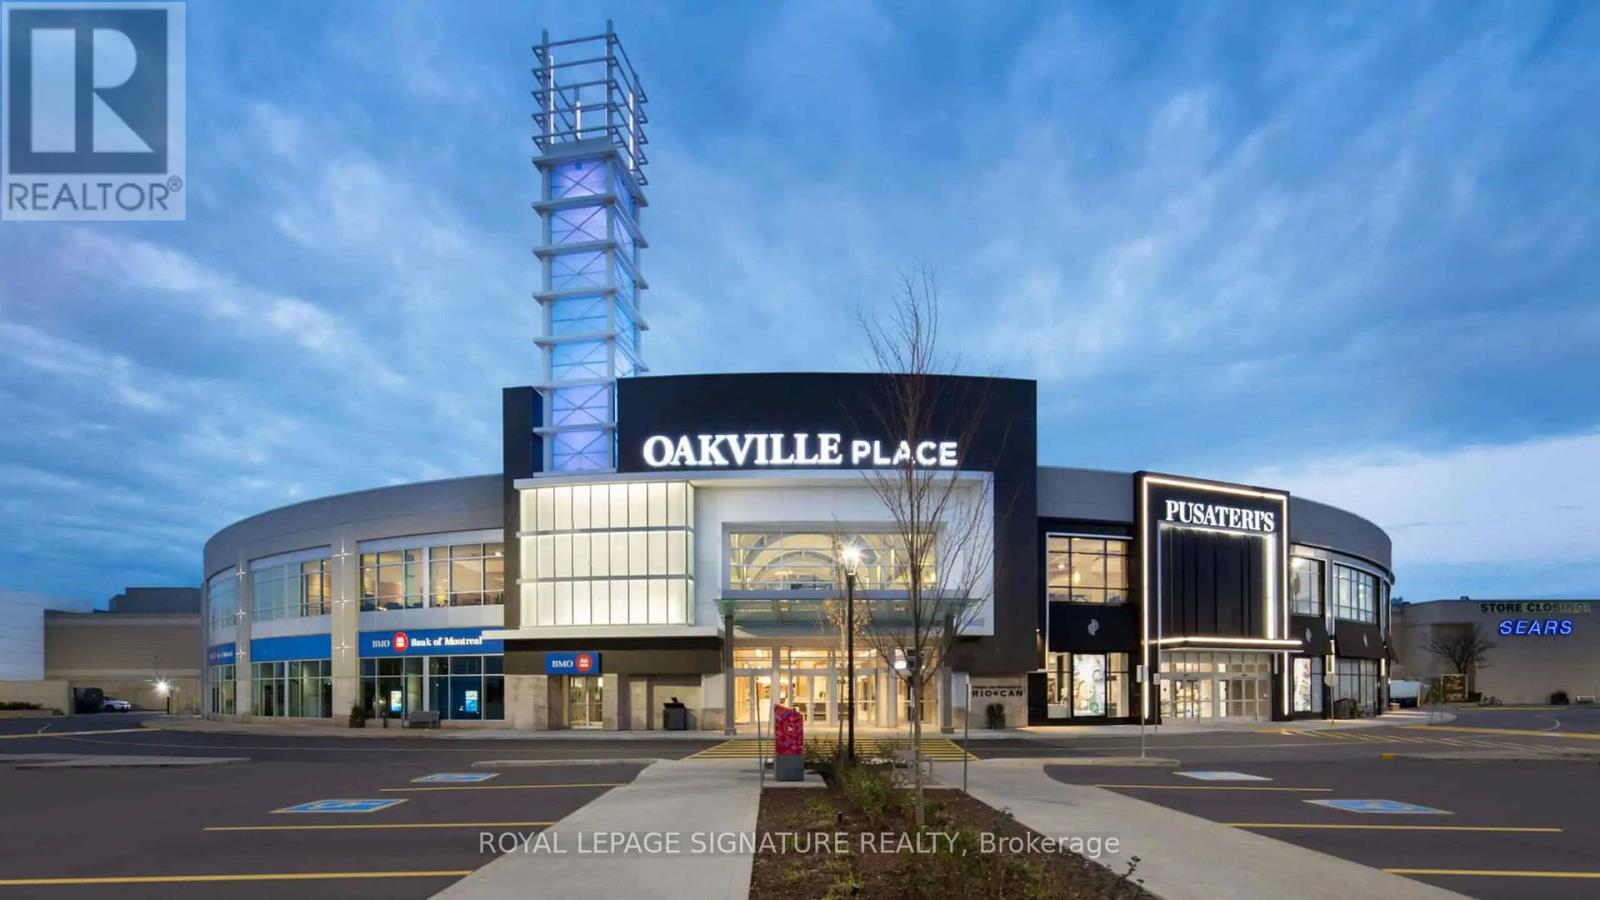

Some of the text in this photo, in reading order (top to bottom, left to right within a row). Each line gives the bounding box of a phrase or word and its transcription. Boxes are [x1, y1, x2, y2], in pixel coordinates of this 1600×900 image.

[642, 433, 958, 467] OAKVILLE PLACE
[1165, 500, 1274, 532] PUSATERI'S
[1480, 603, 1522, 612] STORE
[1500, 619, 1573, 635] SEARS
[372, 635, 483, 648] BMO Bank of Montreal
[552, 659, 574, 668] BMO
